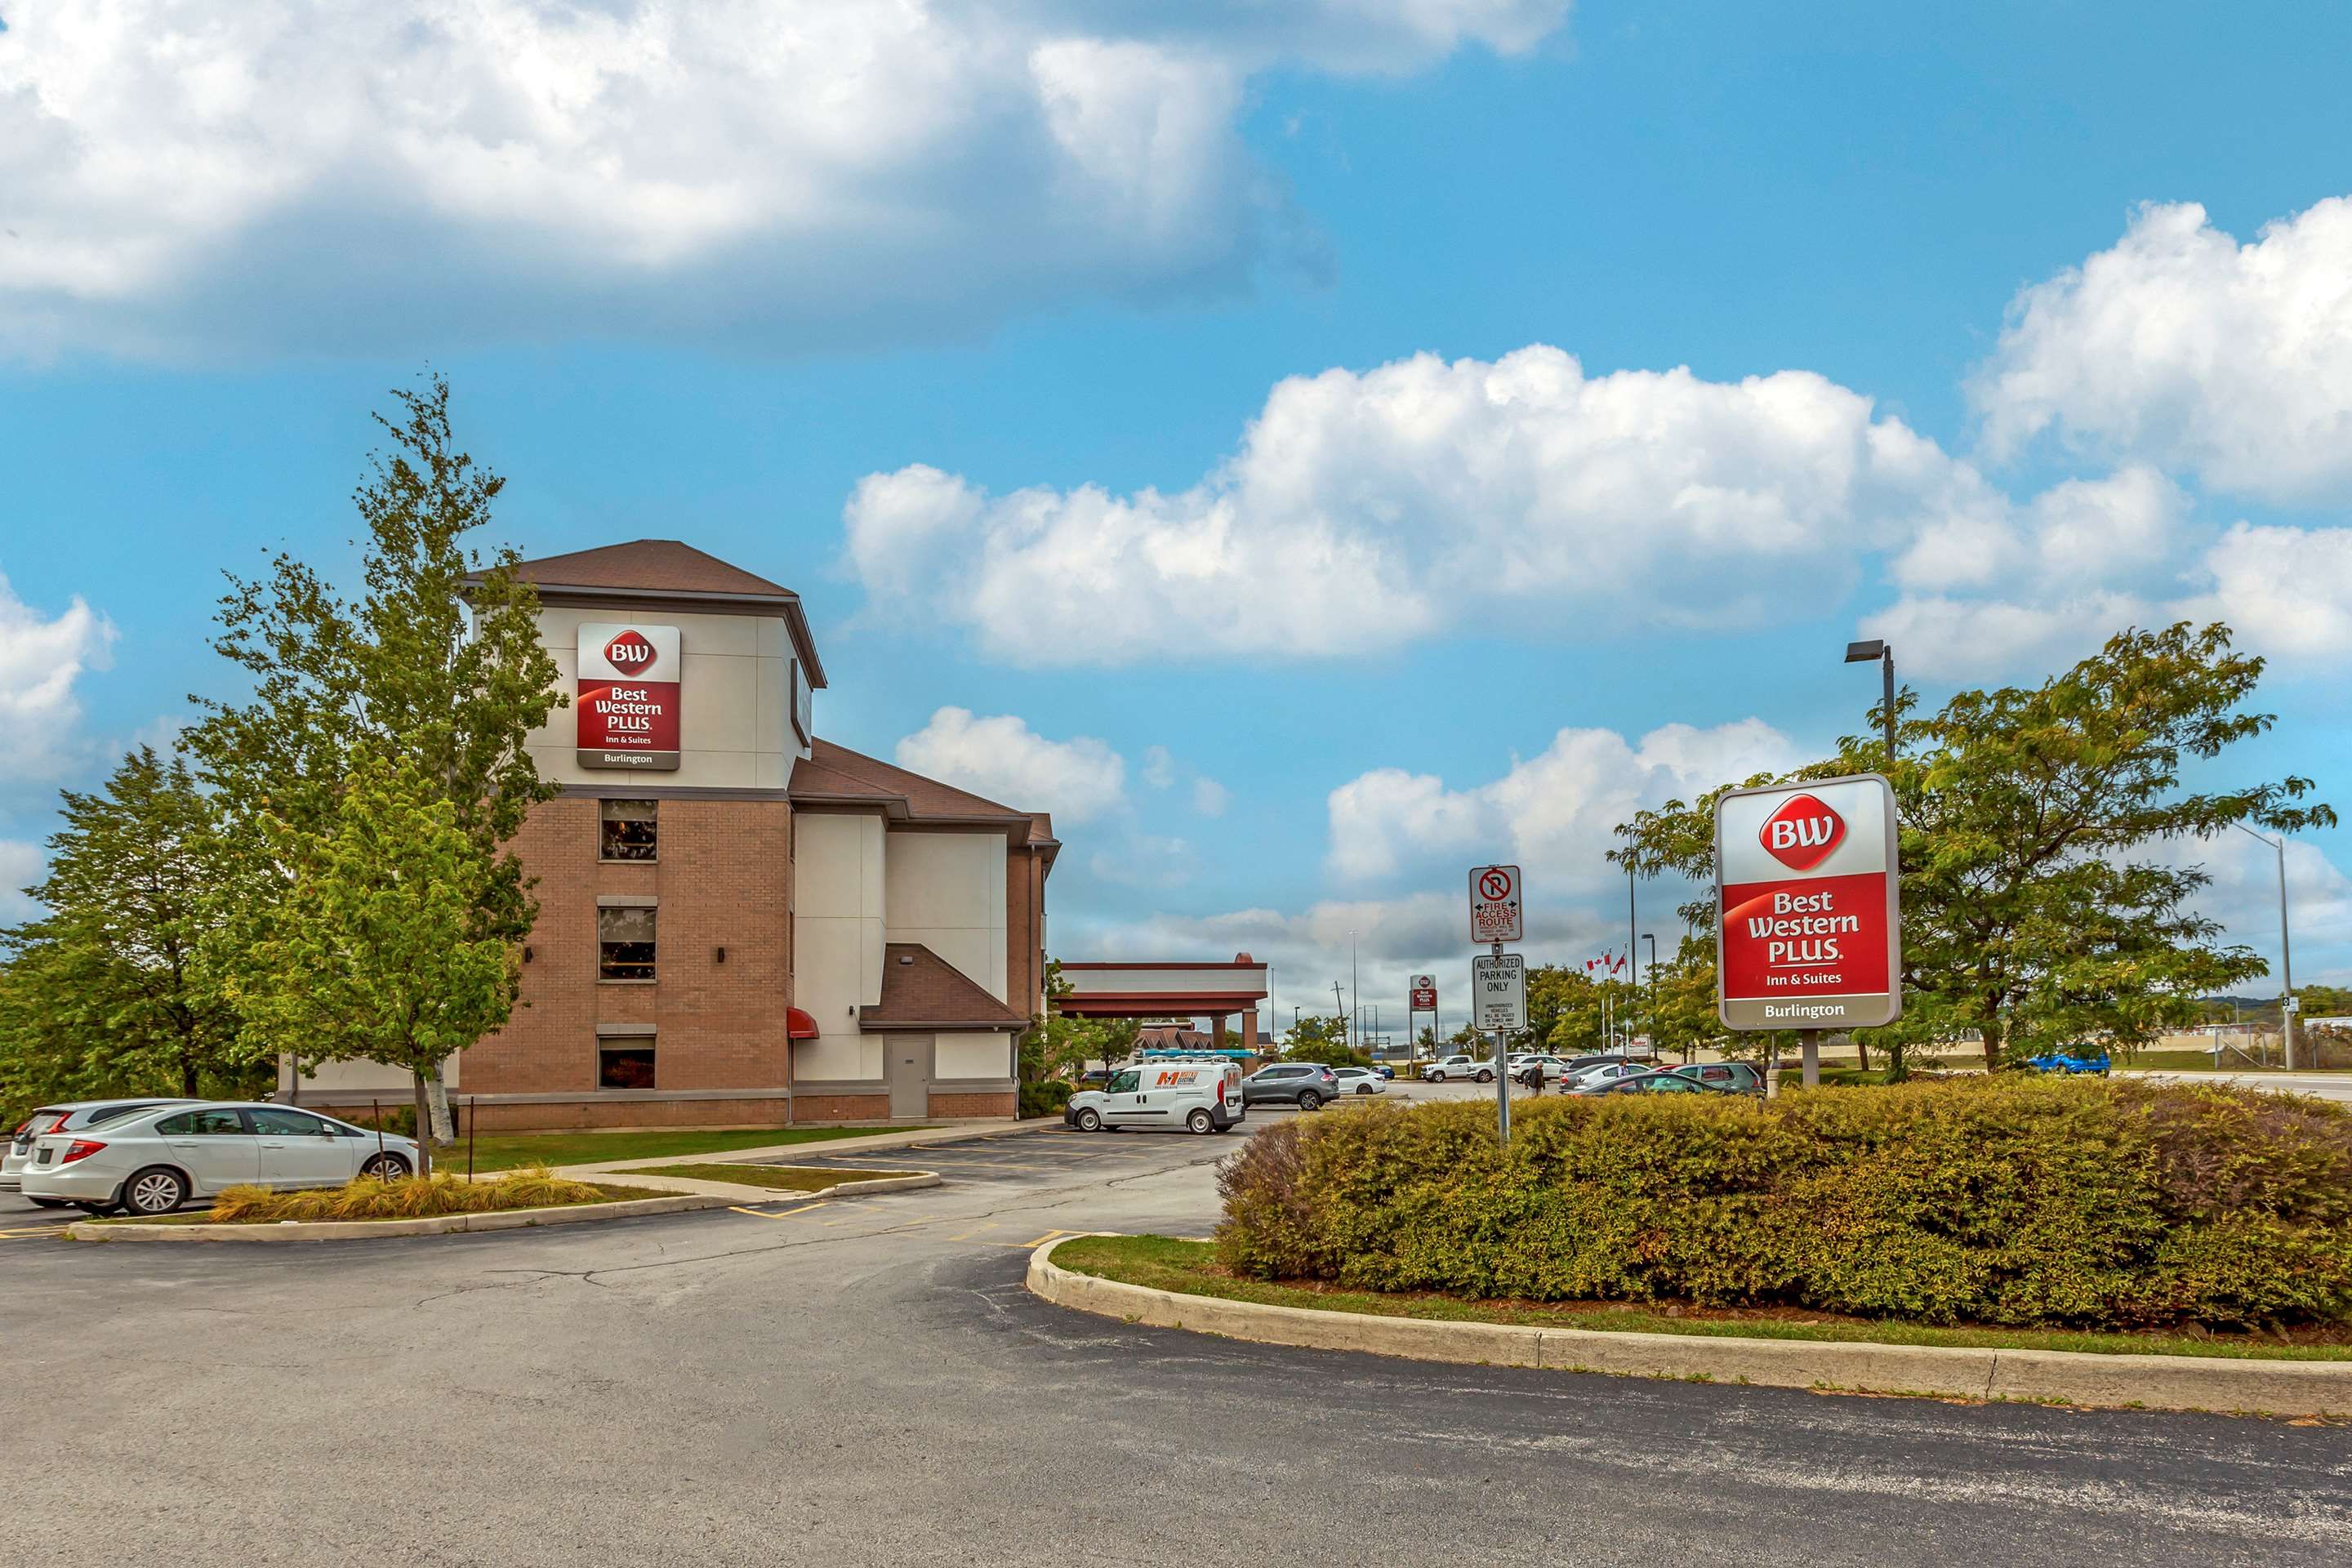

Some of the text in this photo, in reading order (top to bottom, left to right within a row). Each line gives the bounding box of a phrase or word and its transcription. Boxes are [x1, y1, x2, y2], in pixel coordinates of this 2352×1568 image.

[612, 644, 649, 662] BW
[612, 687, 648, 702] Best
[595, 700, 662, 715] Western
[621, 736, 627, 744] &
[604, 754, 653, 764] Burlington
[1771, 816, 1834, 849] BW
[1484, 902, 1508, 911] FIRE
[1774, 891, 1834, 915] Best
[1476, 909, 1517, 919] ACCESS
[1479, 917, 1513, 926] ROUTE
[1748, 915, 1860, 938] Western
[1477, 958, 1520, 969] AUTHORIZED
[1480, 969, 1517, 980] PARKING
[1766, 972, 1842, 987] Inn & Suites
[1487, 982, 1509, 991] ONLY
[1765, 1004, 1846, 1019] Burlington
